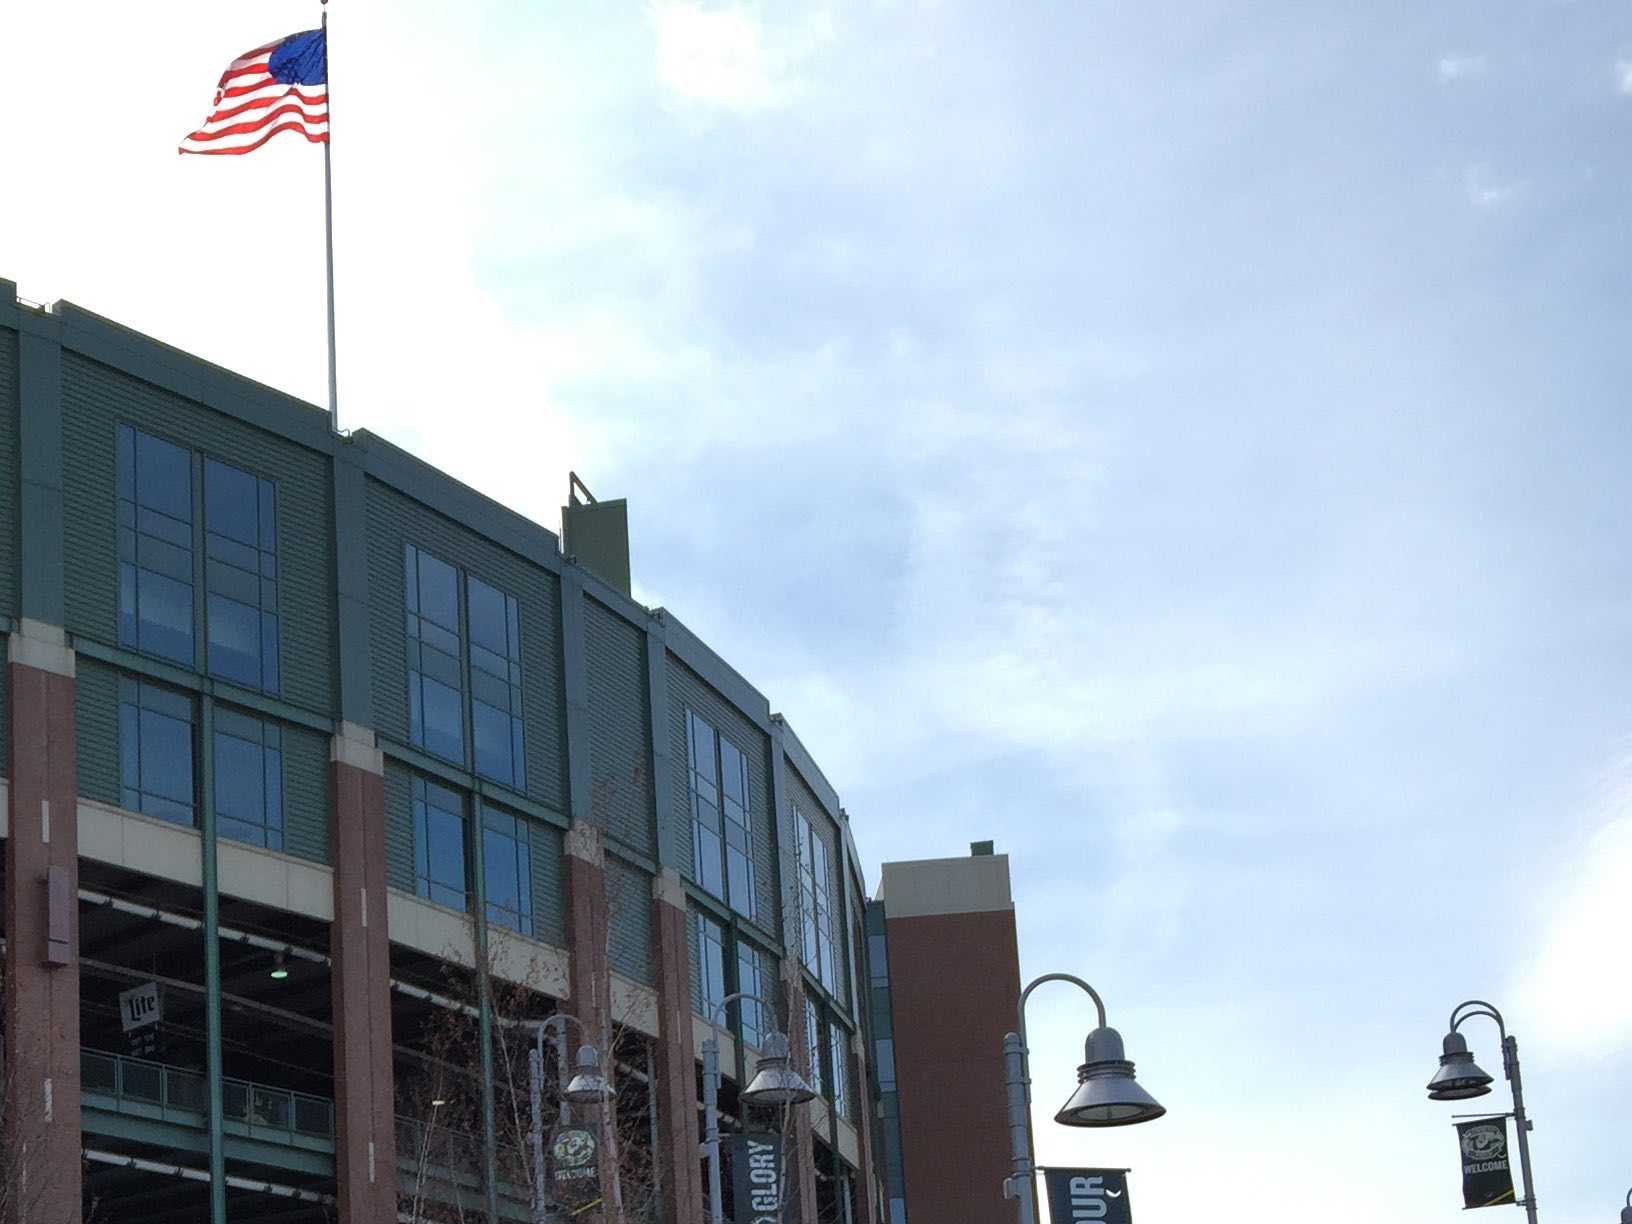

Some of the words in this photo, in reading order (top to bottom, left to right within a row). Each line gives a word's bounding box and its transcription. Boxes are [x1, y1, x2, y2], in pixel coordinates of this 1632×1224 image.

[129, 996, 155, 1021] Lite
[747, 1140, 779, 1211] GLORY
[1464, 1160, 1508, 1174] WELCOME
